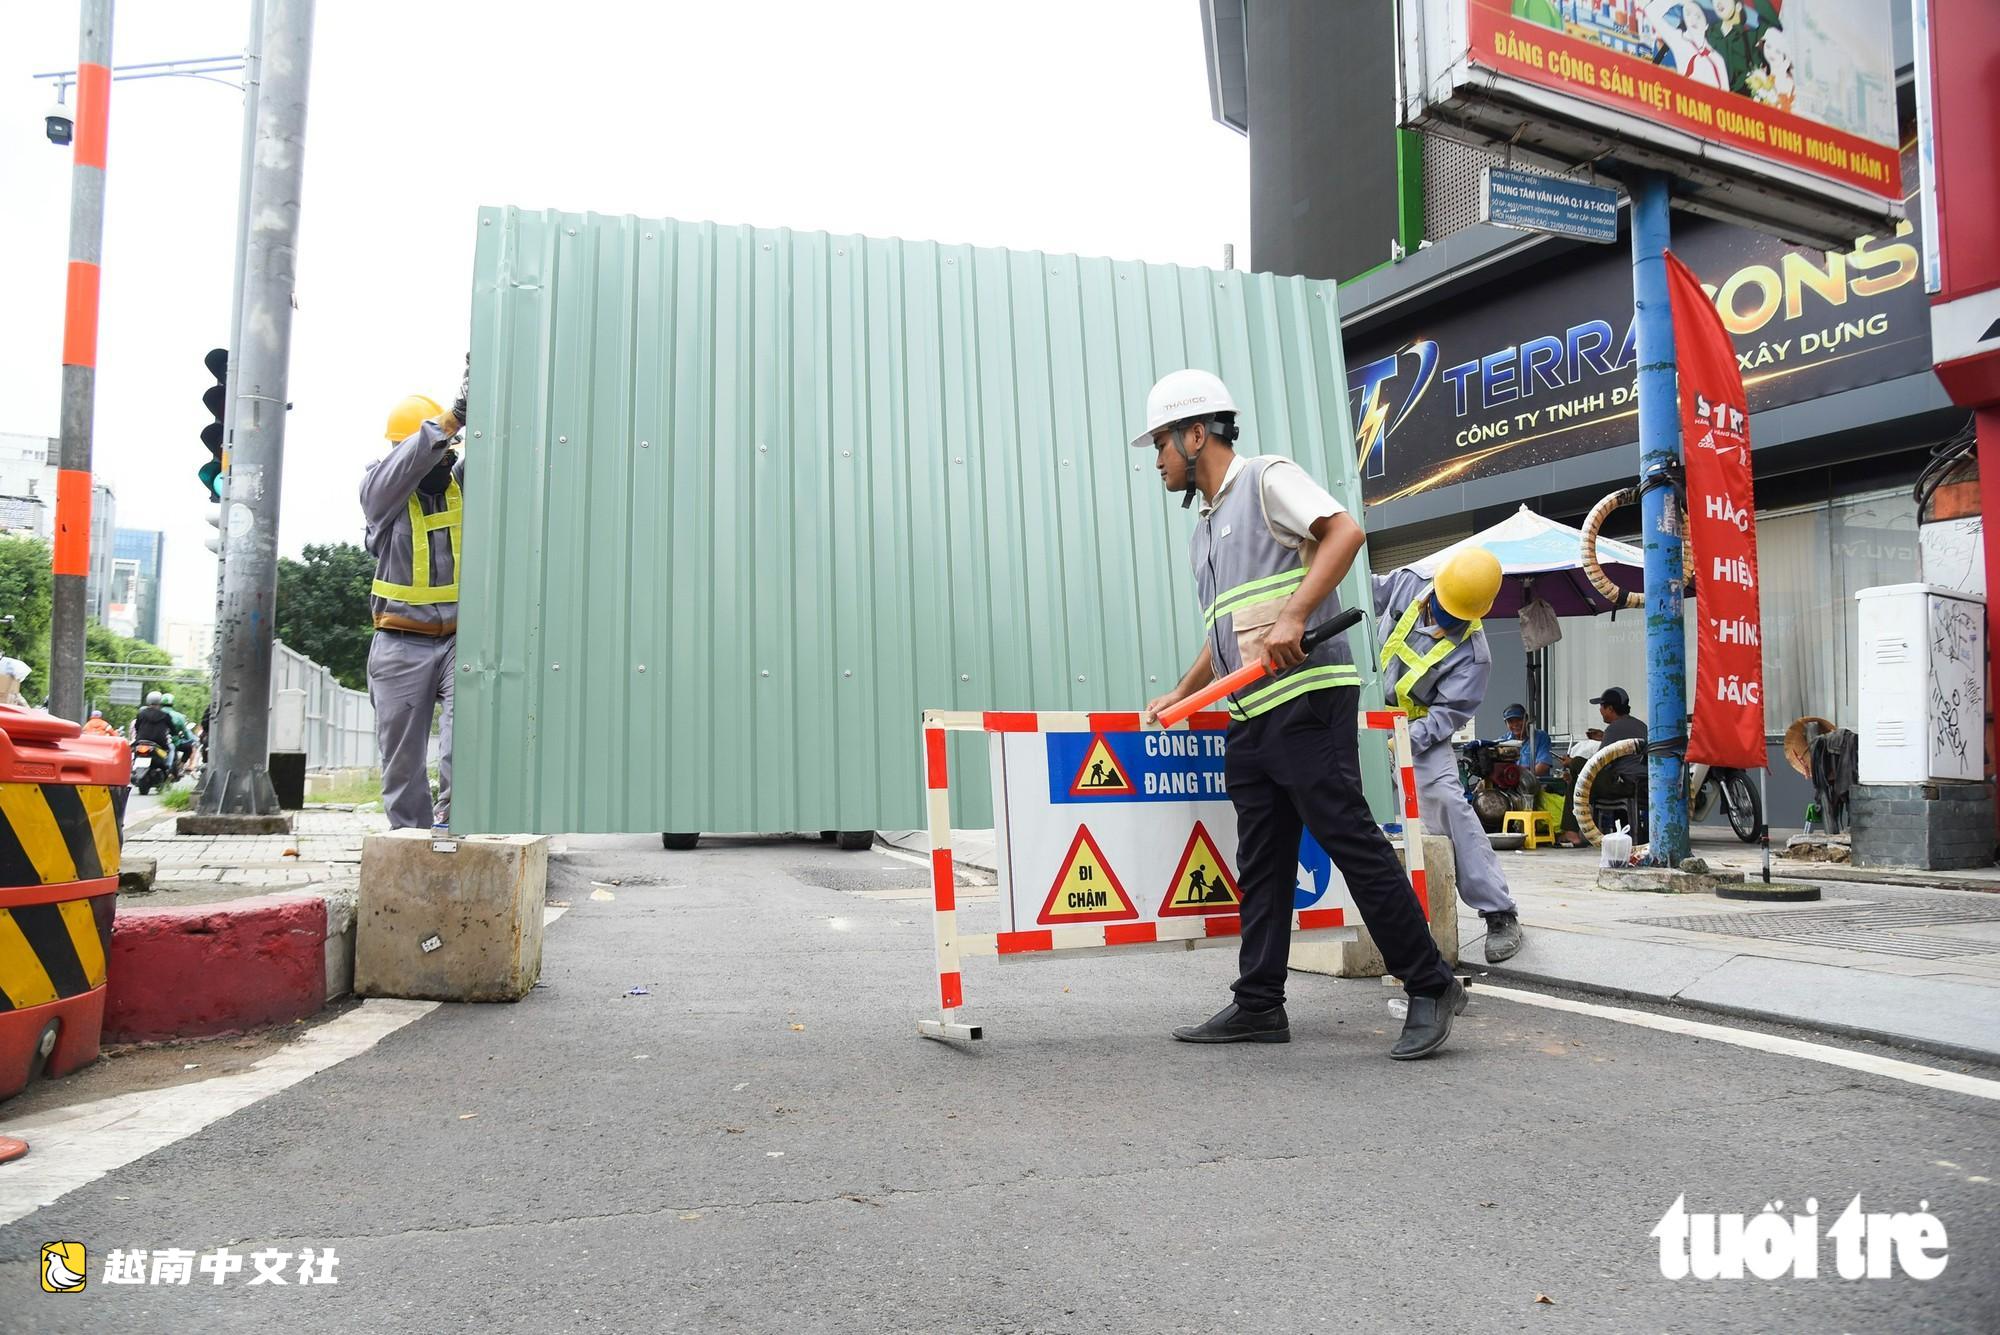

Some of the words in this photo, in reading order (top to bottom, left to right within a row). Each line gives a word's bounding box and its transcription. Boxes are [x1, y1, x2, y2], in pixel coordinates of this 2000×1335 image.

[1495, 30, 1543, 68] ĐẢNG
[1548, 50, 1595, 85] CỘNG
[1600, 65, 1634, 97] SẢN
[1638, 79, 1671, 111] VIỆT
[1676, 94, 1712, 125] NAM
[1716, 108, 1766, 142] QUANG
[1769, 125, 1802, 154] VINH
[1806, 138, 1847, 169] MUÔN
[1851, 152, 1882, 181] NĂM
[1492, 183, 1518, 197] TRUNG
[1519, 187, 1536, 200] TÂM
[1536, 190, 1553, 203] VĂN
[1553, 193, 1570, 206] HÓA
[1571, 197, 1583, 208] Q.1
[1584, 199, 1591, 210] &
[1591, 201, 1615, 214] T-ICON
[1455, 419, 1509, 448] CÔNG
[1515, 410, 1541, 432] TY
[1545, 392, 1604, 423] TNHH
[1735, 340, 1791, 371] XÂY
[1800, 313, 1888, 353] DỰNG
[1145, 731, 1198, 757] CÔNG
[1203, 735, 1225, 757] TR
[1144, 772, 1198, 794] ĐANG
[1203, 772, 1226, 793] TH
[1079, 866, 1092, 881] ĐI
[1068, 889, 1107, 910] CHẬM
